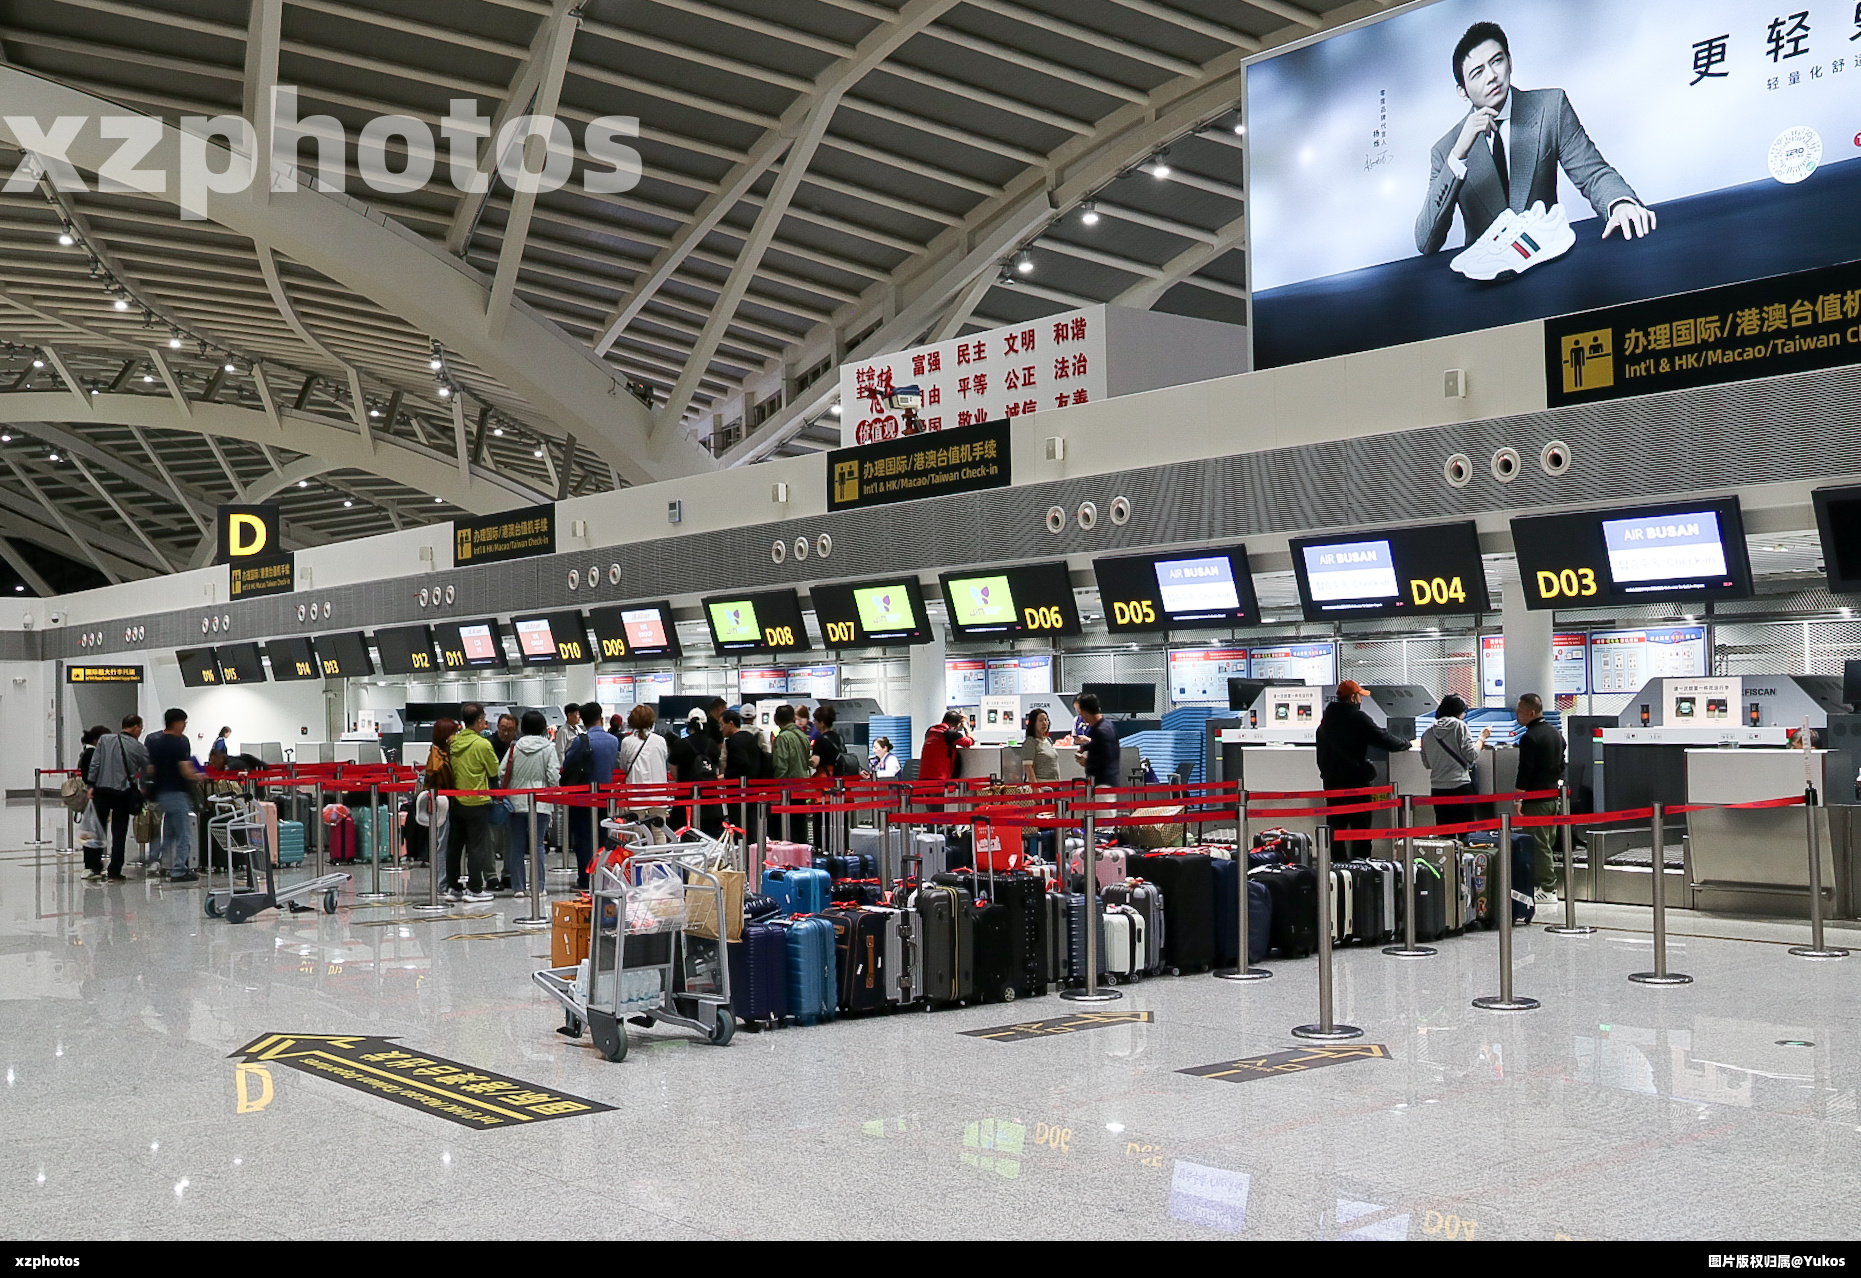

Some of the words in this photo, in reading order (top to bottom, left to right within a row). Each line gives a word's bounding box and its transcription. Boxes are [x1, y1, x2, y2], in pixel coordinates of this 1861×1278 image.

[1623, 289, 1861, 356] 办理国际/港澳台值机
[912, 351, 941, 377] 富强
[957, 340, 987, 366] 民主
[1004, 329, 1035, 356] 文明
[1053, 316, 1087, 345] 和谐
[1624, 358, 1656, 379] Int'l
[1658, 357, 1671, 373] &
[1674, 331, 1841, 372] HK/Macao/Taiwan
[957, 373, 988, 399] 平等
[1004, 366, 1036, 390] 公正
[1054, 352, 1088, 380] 法治
[863, 439, 997, 480] 办理国际/港澳台值机手续
[878, 482, 885, 492] &
[961, 463, 998, 480] Check-in
[229, 513, 266, 556] D
[1624, 527, 1644, 541] AIR
[1646, 523, 1700, 540] BUSAN
[1319, 553, 1335, 565] AIR
[1336, 550, 1377, 563] BUSAN
[1169, 567, 1183, 579] AIR
[1183, 565, 1219, 578] BUSAN
[1410, 576, 1466, 605] D04
[1536, 567, 1598, 599] D03
[1024, 606, 1063, 630] D06
[1114, 600, 1156, 625] D05
[765, 625, 795, 647] D08
[826, 621, 855, 642] D07
[558, 641, 582, 660] D10
[602, 638, 625, 657] D09
[295, 662, 312, 676] D14
[323, 659, 340, 674] D13
[411, 652, 431, 669] D12
[445, 650, 465, 667] D11
[201, 669, 215, 683] D16
[223, 667, 238, 681] D15
[1744, 688, 1776, 697] FISCAN
